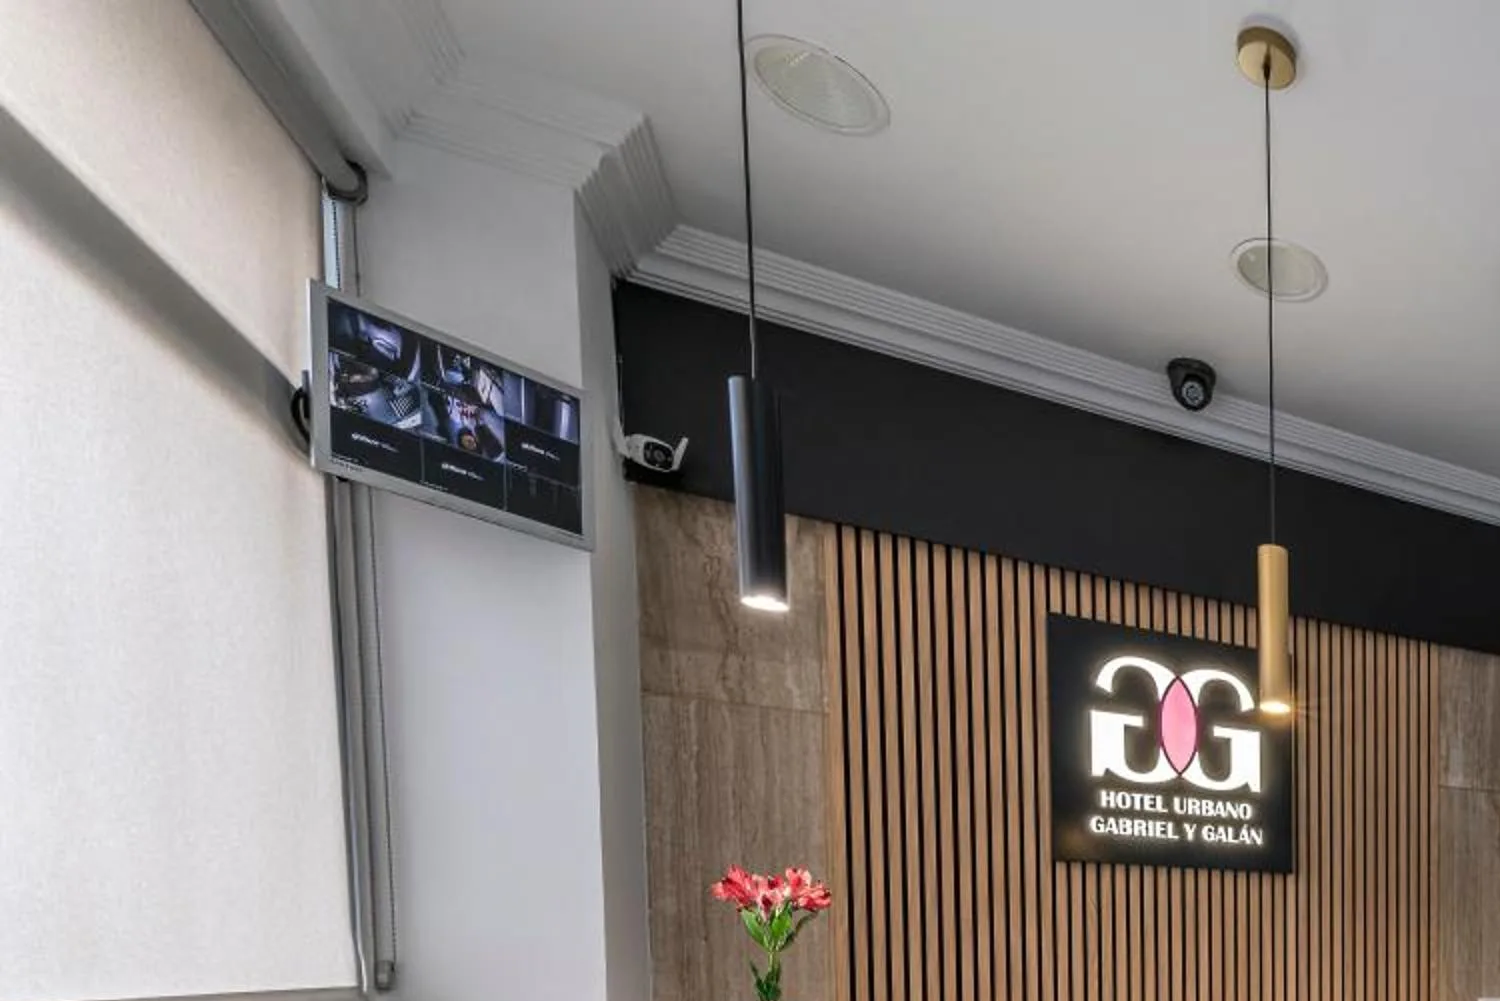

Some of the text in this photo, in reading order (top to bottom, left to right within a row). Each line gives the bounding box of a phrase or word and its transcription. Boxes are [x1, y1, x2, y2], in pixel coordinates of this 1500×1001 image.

[1100, 790, 1252, 820] HOTEL URBANO
[1090, 816, 1178, 839] GABRIEL
[1184, 823, 1197, 841] Y
